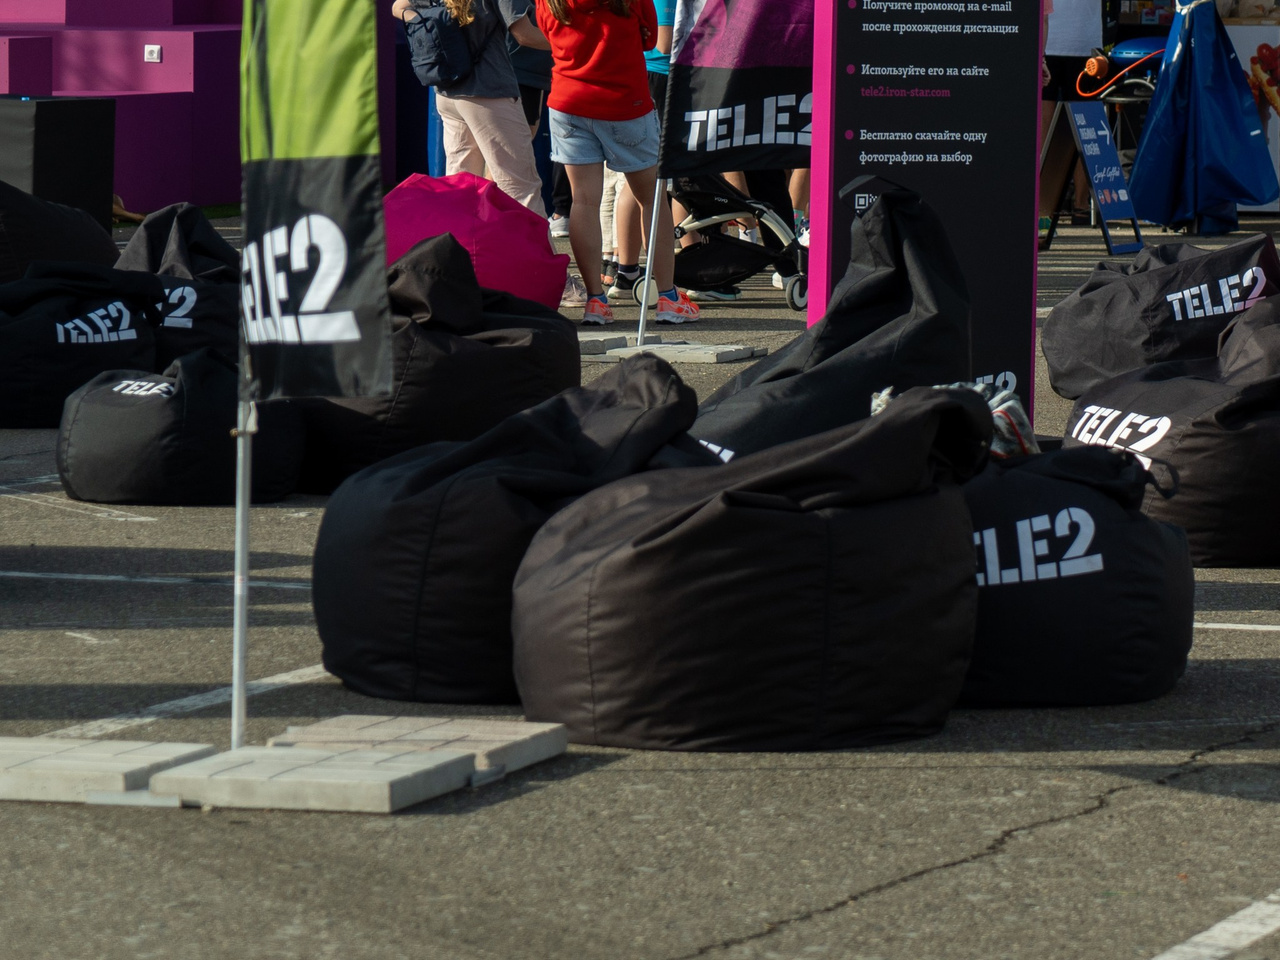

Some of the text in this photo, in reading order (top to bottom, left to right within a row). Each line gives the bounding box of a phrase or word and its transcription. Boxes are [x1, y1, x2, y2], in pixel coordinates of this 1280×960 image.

[914, 2, 966, 14] промокод
[967, 3, 980, 11] на
[982, 1, 1012, 12] e-mail
[862, 23, 1019, 35] после прохождения дистанции
[861, 63, 989, 78] Используйте его на сайте
[861, 86, 951, 97] tele2.iron-star.com
[860, 129, 987, 143] Бесплатно скачайте одну
[859, 151, 973, 165] фотографию на выбор
[1166, 266, 1267, 321] TELE2
[1071, 404, 1172, 471] TELE2
